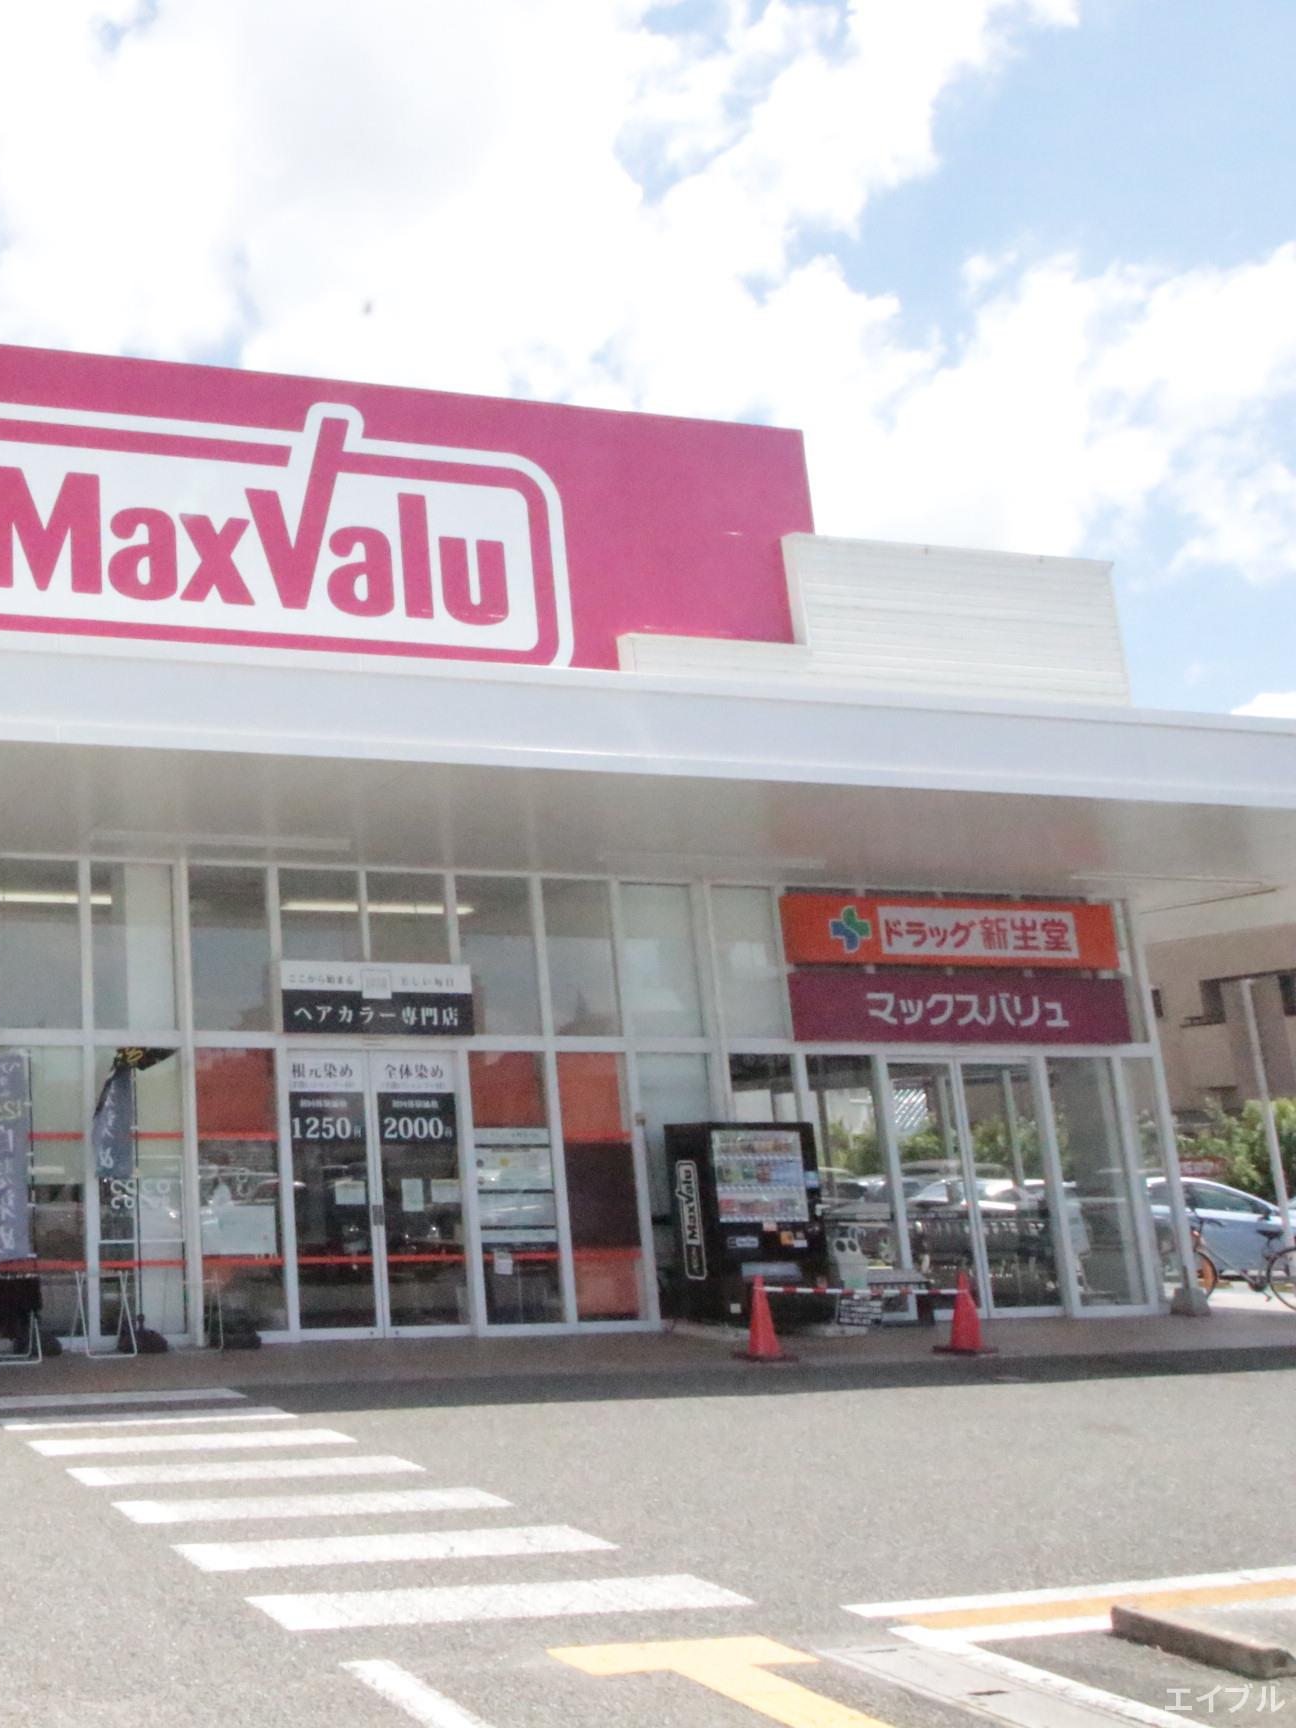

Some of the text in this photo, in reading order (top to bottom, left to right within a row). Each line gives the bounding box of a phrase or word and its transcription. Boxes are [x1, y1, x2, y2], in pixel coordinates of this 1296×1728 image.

[884, 916, 1072, 952] ドラッグ新生堂
[294, 1006, 459, 1027] ヘアカラー専門店
[866, 992, 1070, 1027] マックスバリュ
[292, 1063, 353, 1079] 根元染め
[384, 1063, 444, 1079] 全体染め
[677, 1169, 700, 1241] MaxValu
